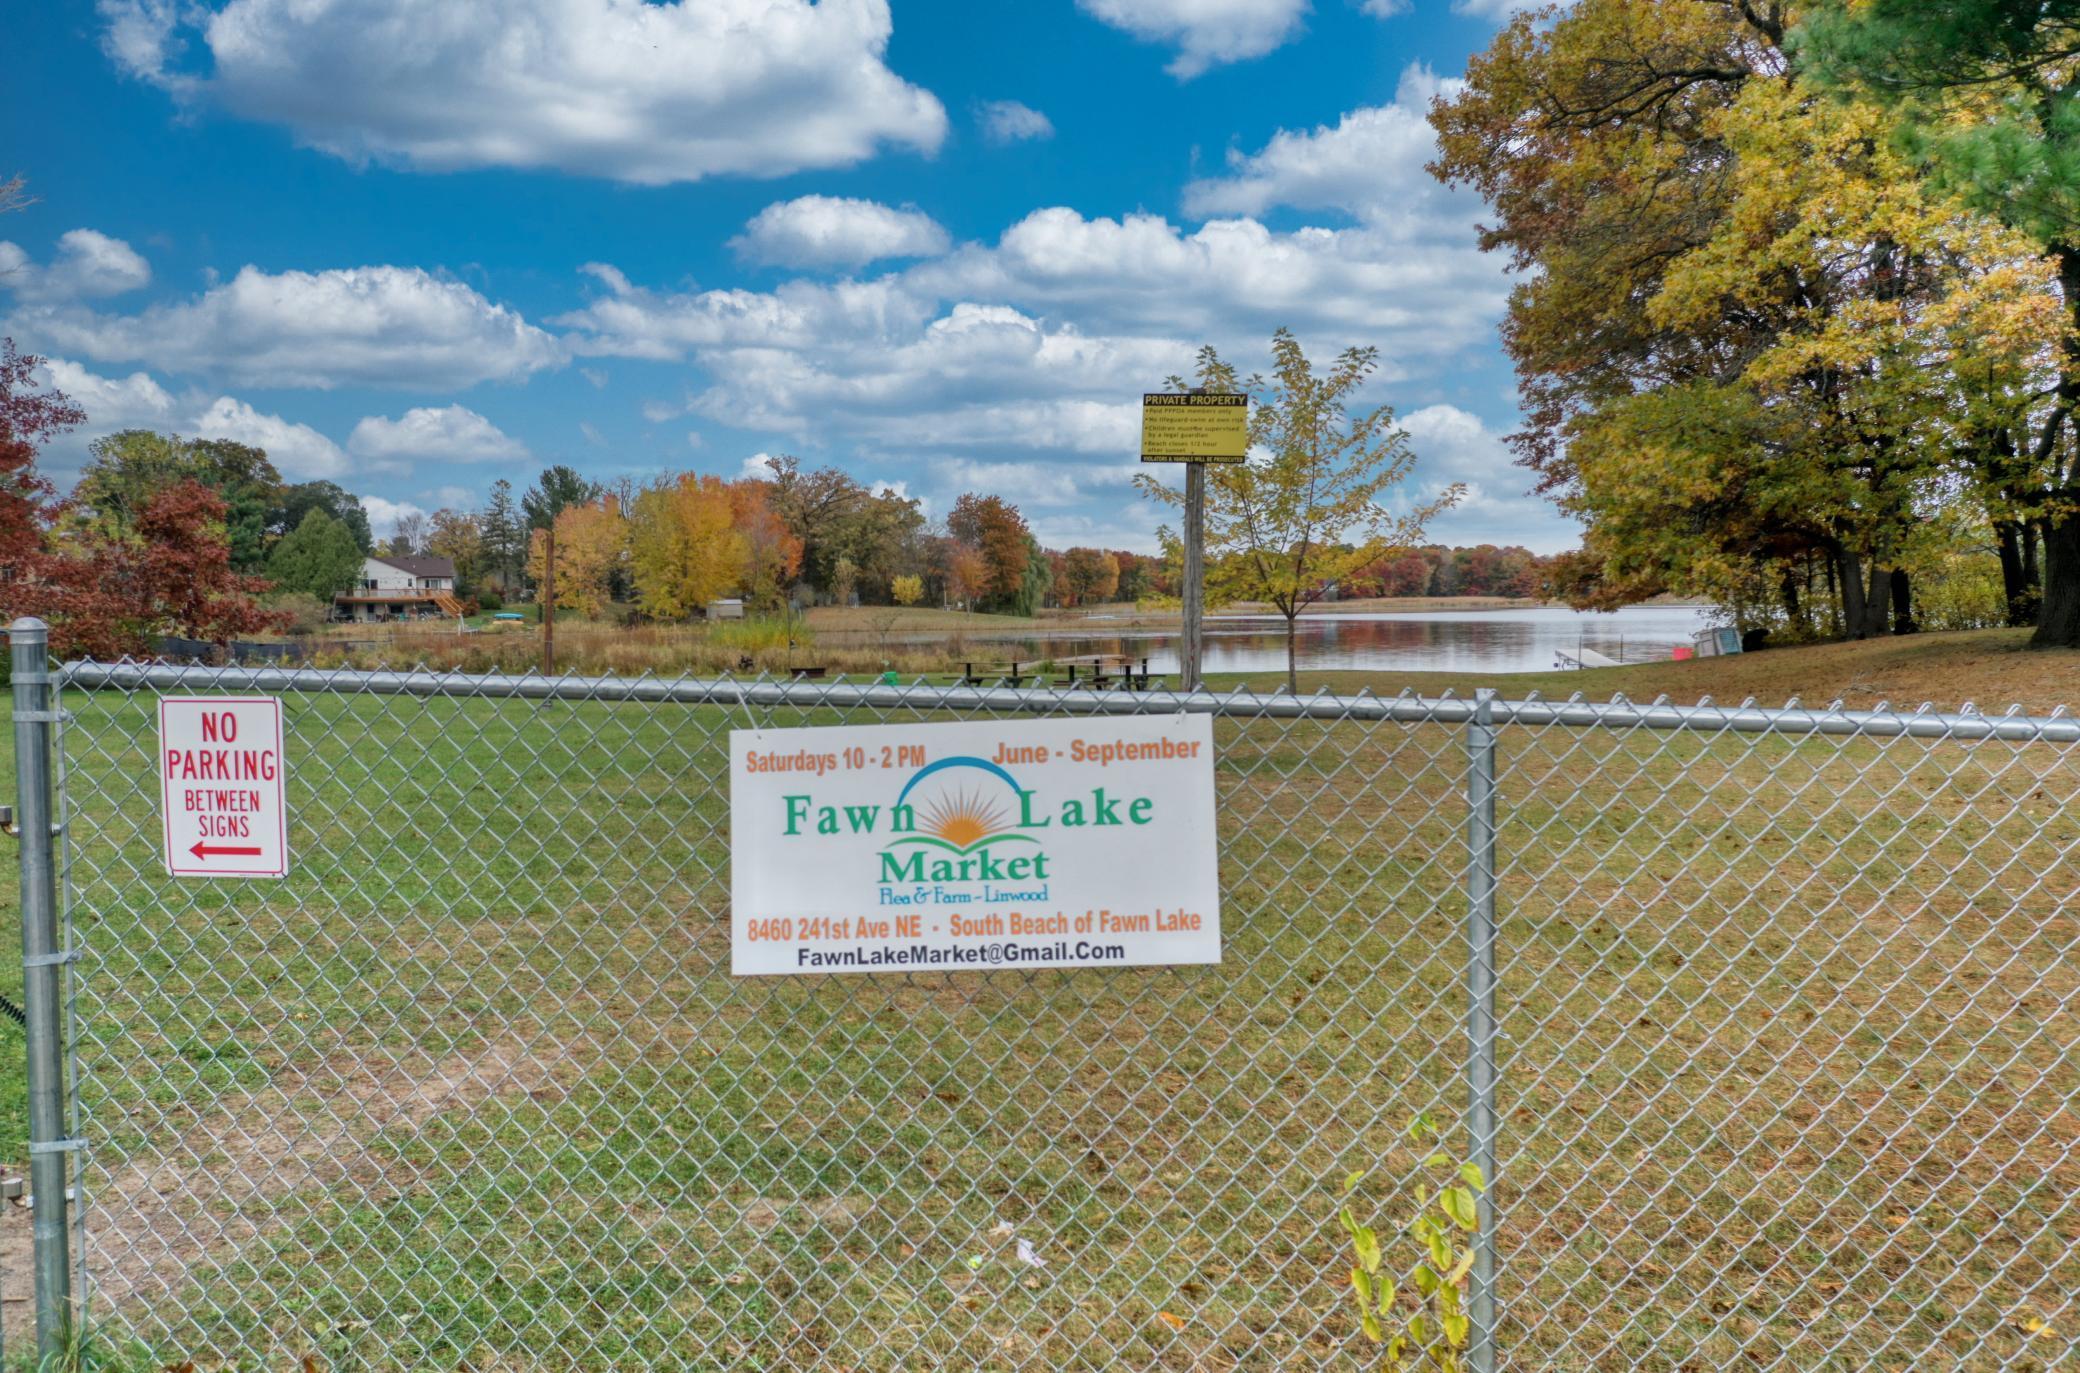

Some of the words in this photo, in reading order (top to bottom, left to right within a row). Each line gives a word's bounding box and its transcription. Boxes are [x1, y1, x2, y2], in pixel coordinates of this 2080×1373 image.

[1145, 396, 1186, 404] PRIVATE
[1190, 396, 1245, 404] PROPERTY
[202, 712, 237, 743] NO
[168, 749, 275, 781] PARKING
[745, 746, 837, 776] Saturdays
[843, 747, 865, 769] 10
[882, 746, 892, 769] 2
[898, 745, 926, 767] PM
[993, 743, 1048, 765] June
[1071, 736, 1200, 767] September
[185, 789, 260, 813] BETWEEN
[781, 794, 916, 836] Fawn
[1015, 786, 1155, 828] Lake
[199, 815, 250, 837] SIGNS
[875, 848, 1051, 884] Market
[879, 887, 911, 905] Flea
[914, 888, 932, 905] &
[934, 888, 972, 904] Farm
[983, 884, 1049, 903] Linwood
[748, 918, 793, 942] 8460
[799, 917, 850, 941] 241st
[855, 916, 890, 938] Ave
[895, 914, 921, 938] NE
[950, 913, 1004, 937] South
[1009, 912, 1068, 936] Beach
[1075, 911, 1092, 933] of
[1100, 910, 1150, 933] Fawn
[1156, 910, 1201, 932] Lake
[799, 942, 1123, 965] FawnLakeMarket@Gmail.Com
